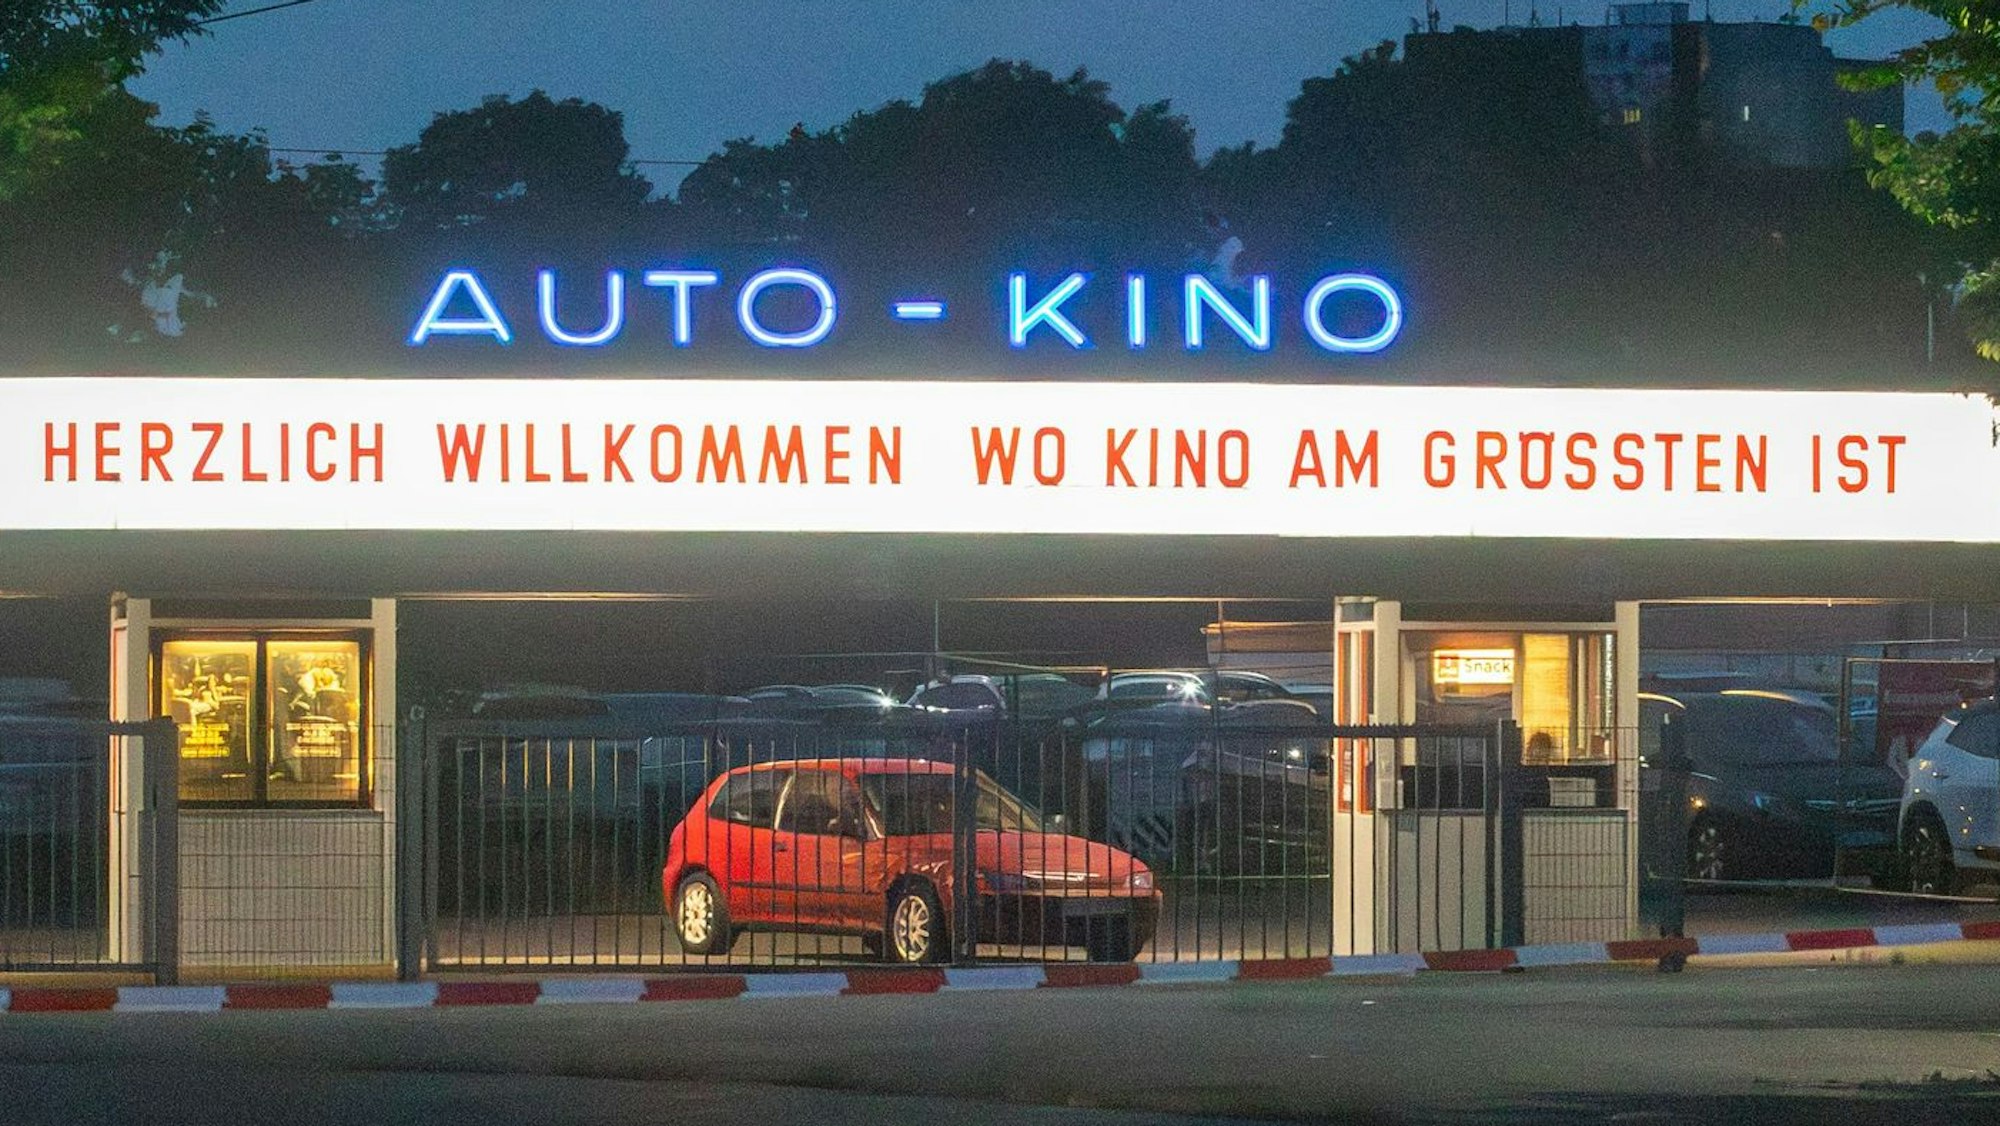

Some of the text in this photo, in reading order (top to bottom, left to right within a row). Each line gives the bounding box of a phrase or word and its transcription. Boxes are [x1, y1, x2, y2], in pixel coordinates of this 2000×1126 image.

[412, 269, 837, 347] AUTO
[1008, 271, 1404, 353] KINO
[45, 423, 1905, 493] HERZLICH WILLKOMMEN WO KINO AM GRÖSSTEN IST
[1464, 657, 1511, 674] Snack
